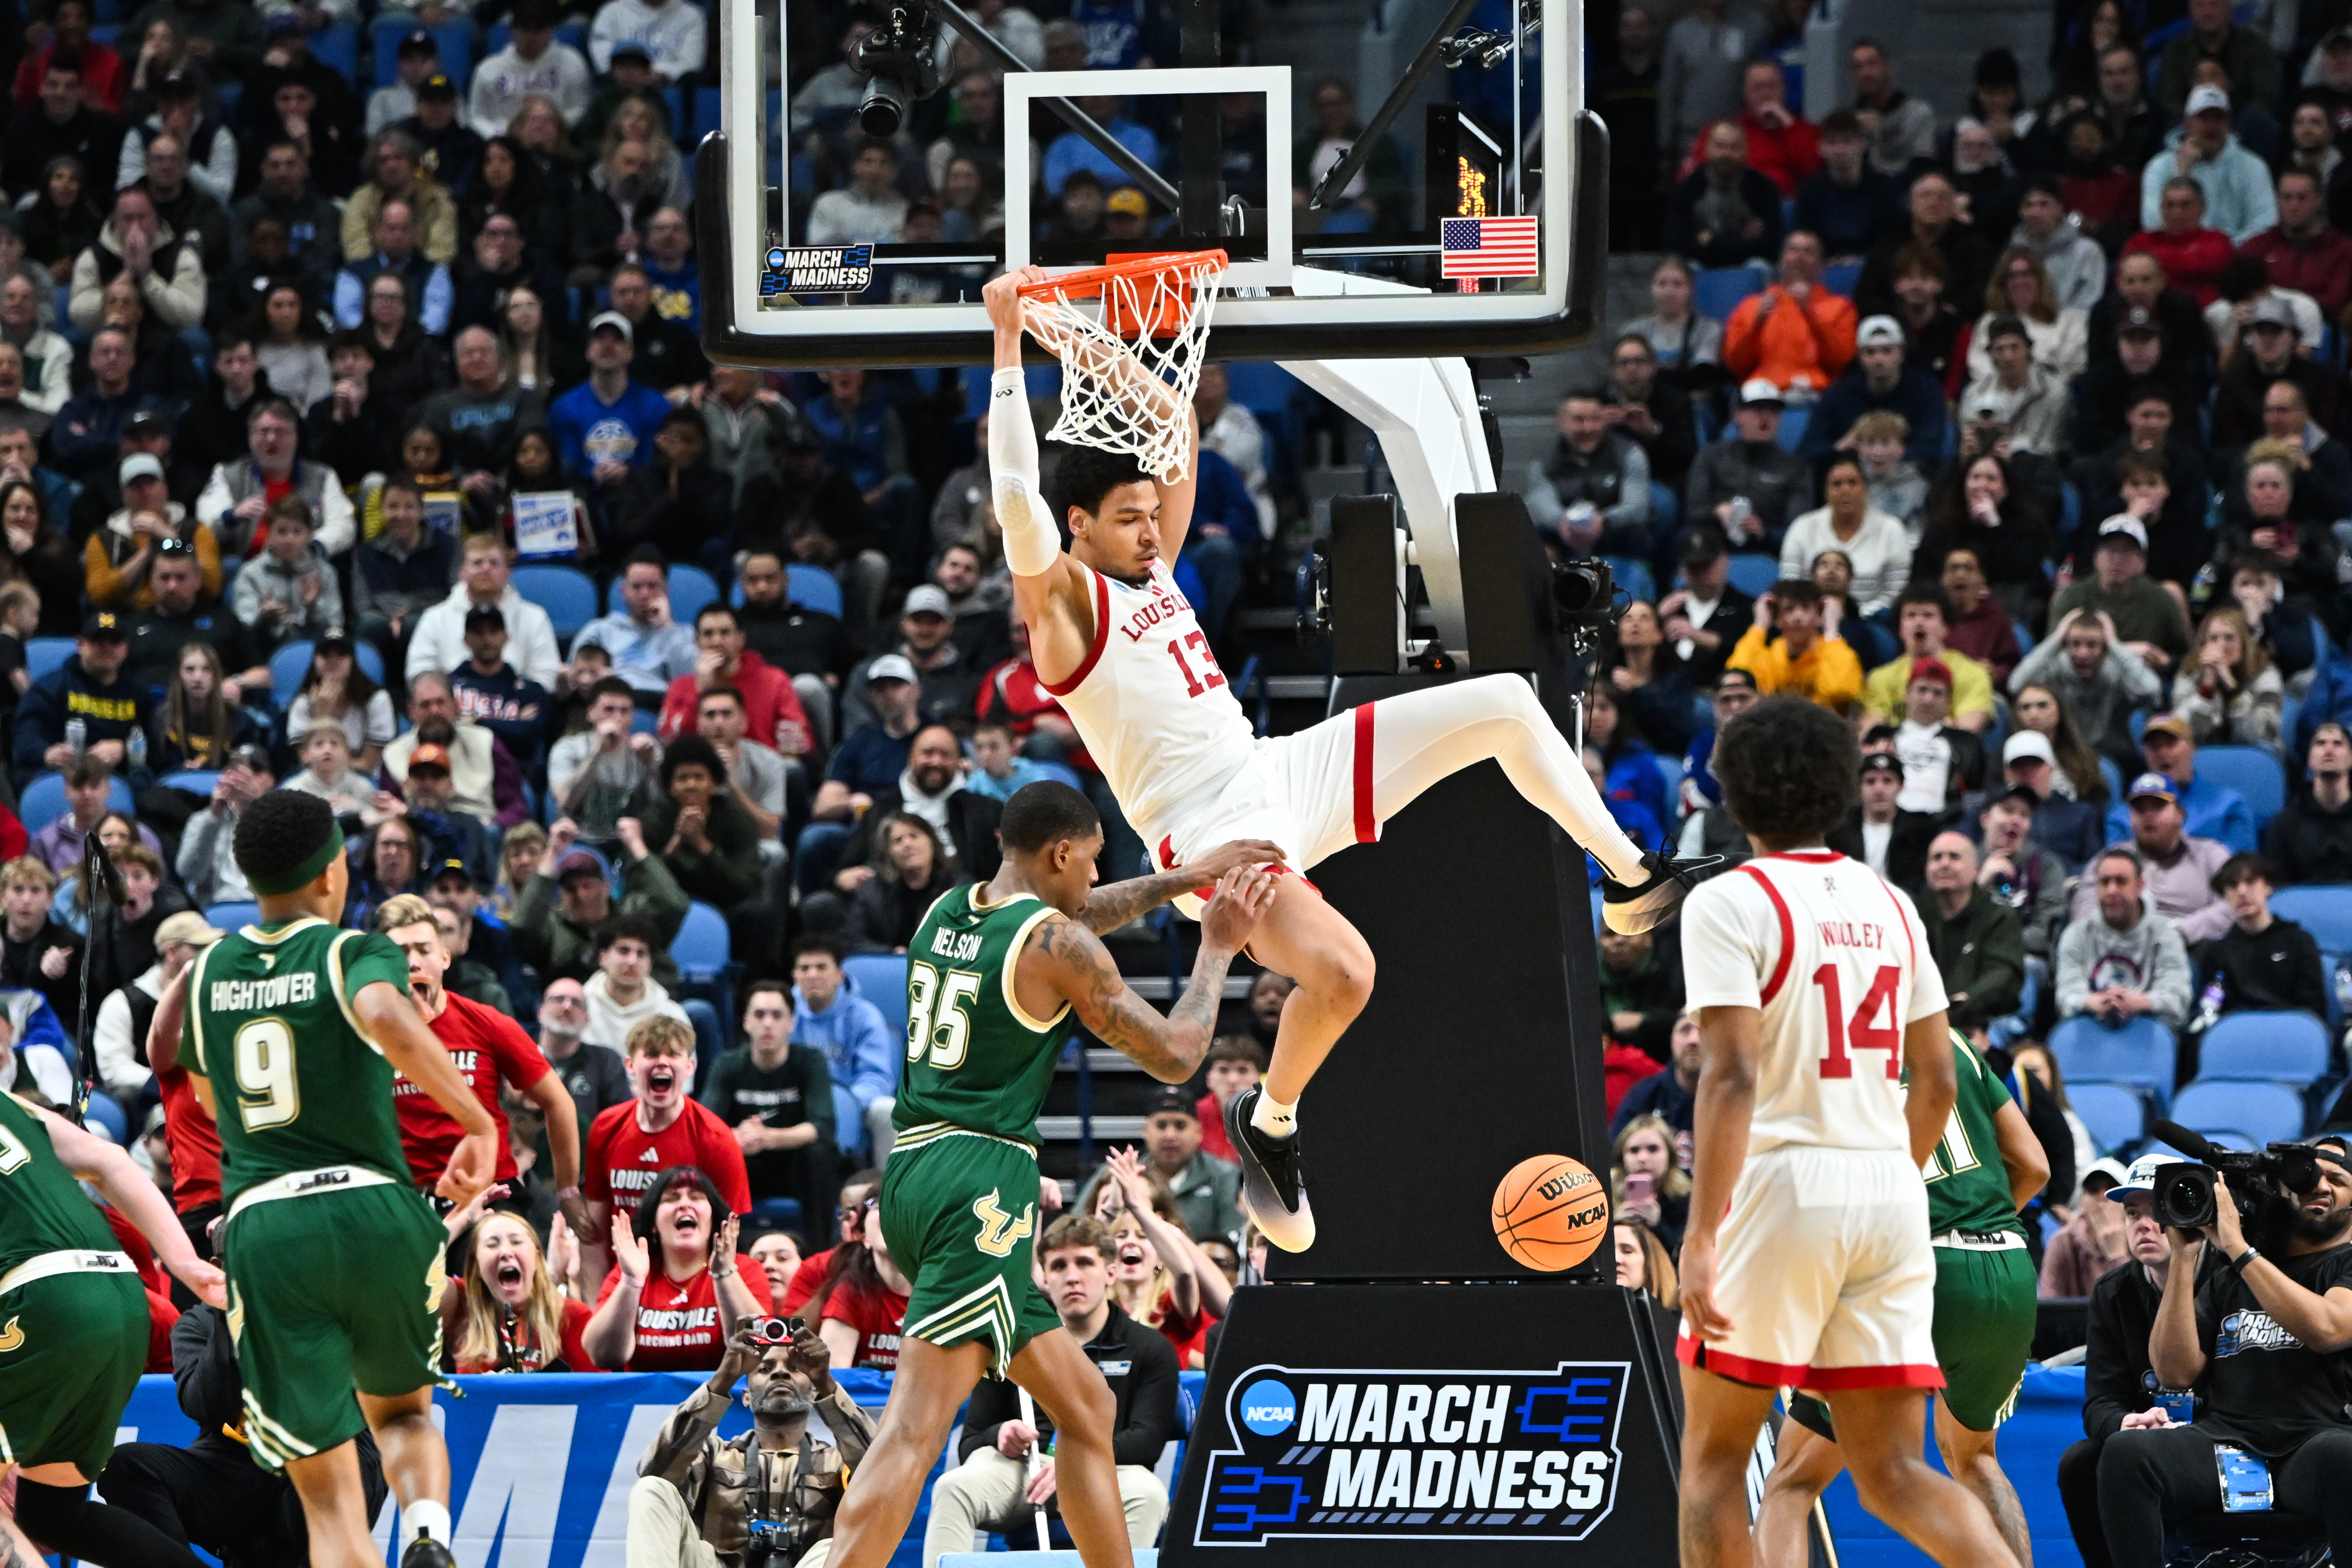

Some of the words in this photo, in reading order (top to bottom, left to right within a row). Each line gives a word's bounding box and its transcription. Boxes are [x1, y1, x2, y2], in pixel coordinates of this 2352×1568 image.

[785, 250, 842, 268] MARCH
[792, 267, 869, 286] MADNESS
[1167, 630, 1226, 698] 13
[930, 926, 983, 962] NELSON
[211, 972, 316, 1012] HIGHTOWER
[1812, 963, 1901, 1081] 14
[234, 1016, 301, 1133] 9
[610, 1168, 658, 1191] LOUIS
[1536, 1171, 1600, 1201] Wilson
[1567, 1202, 1606, 1230] NCAA
[2238, 1311, 2279, 1330] MARC
[636, 1334, 682, 1347] ARCHING
[1246, 1406, 1294, 1421] NCAA
[1297, 1383, 1511, 1444] MARCH
[1321, 1448, 1609, 1510] MADNESS
